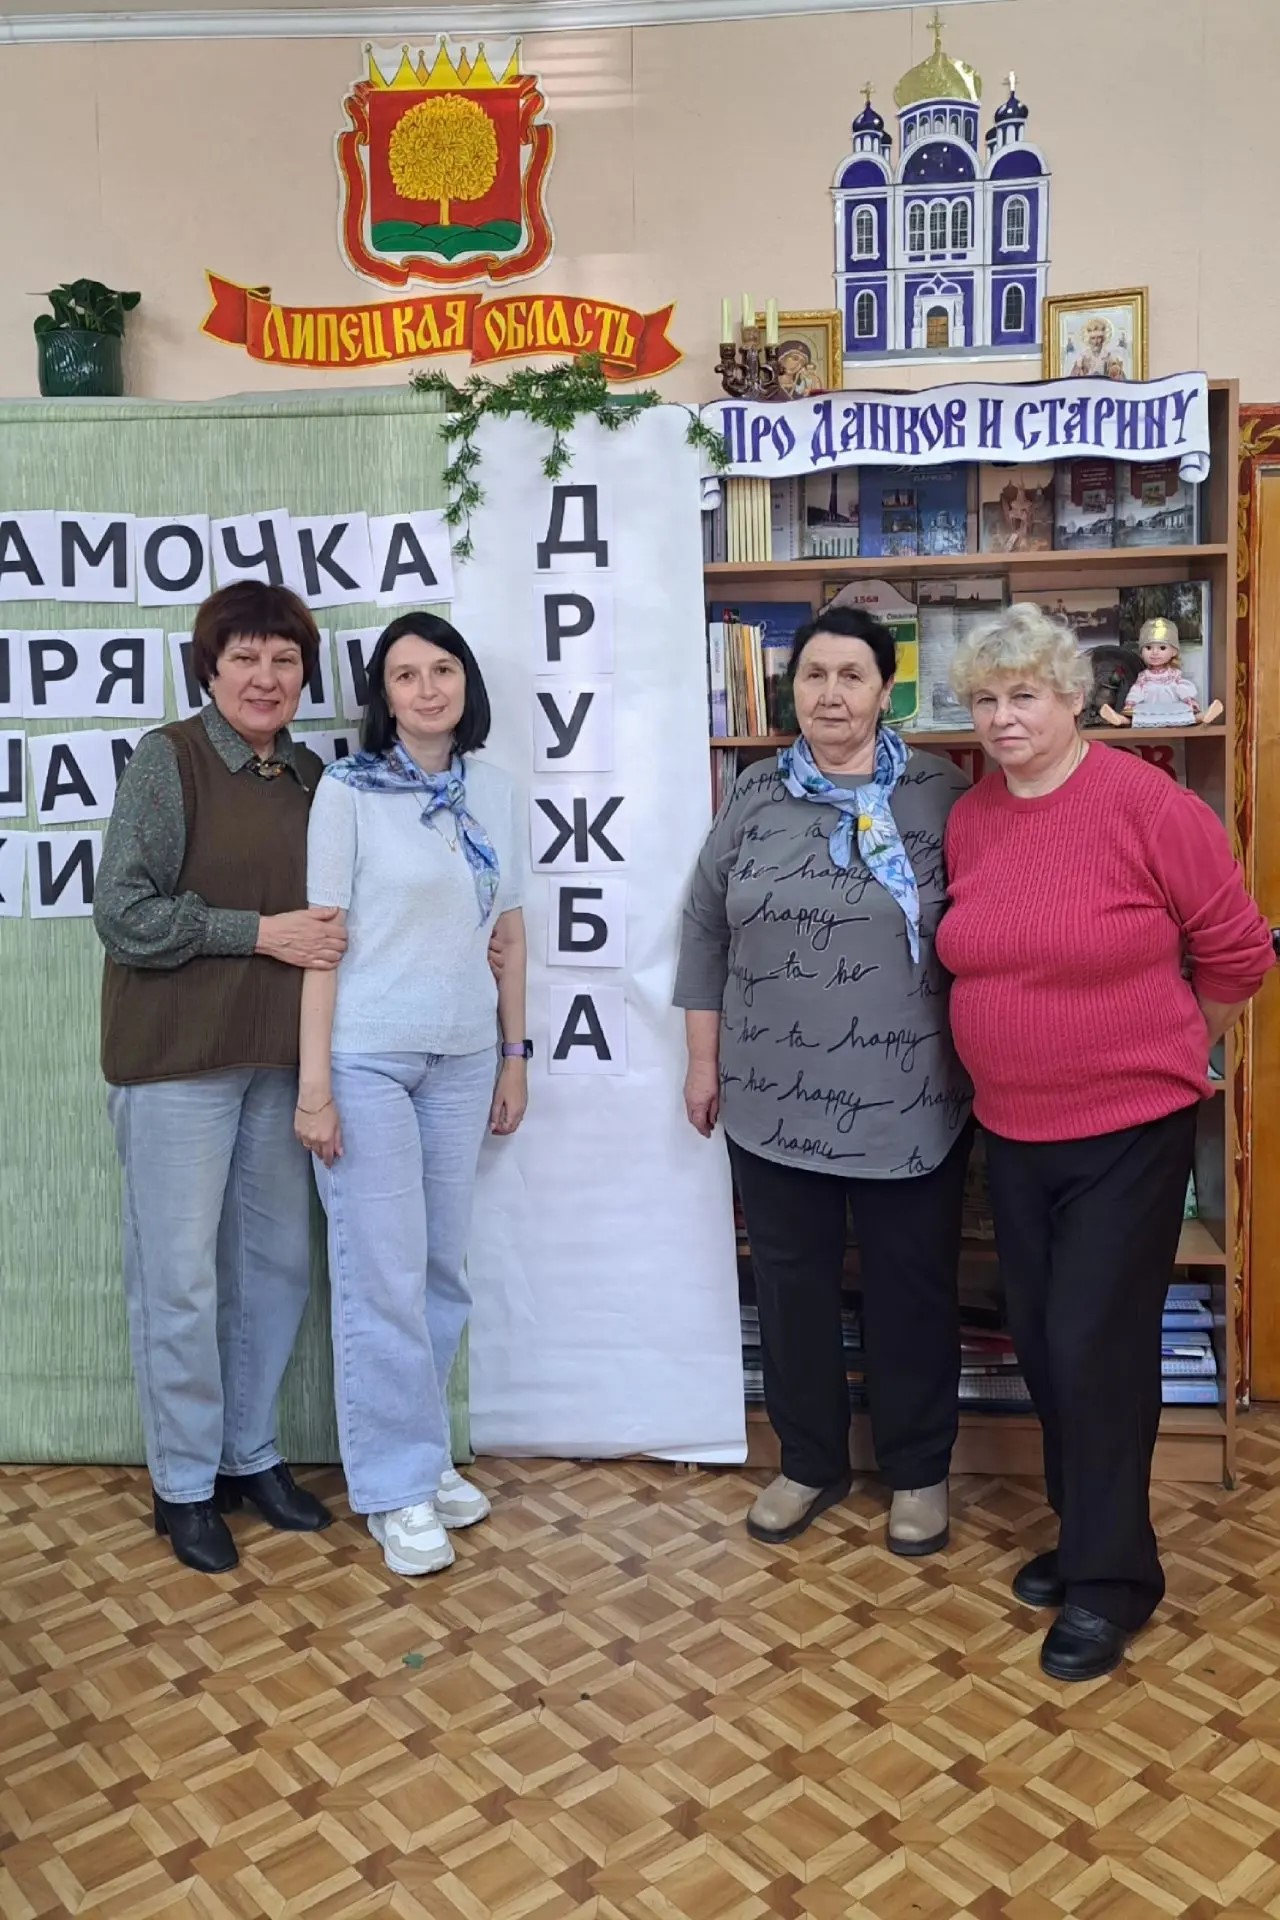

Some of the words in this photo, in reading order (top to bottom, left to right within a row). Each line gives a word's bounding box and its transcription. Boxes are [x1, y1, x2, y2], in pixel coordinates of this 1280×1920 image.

[483, 300, 636, 359] ОБЛАСТЬ
[978, 397, 1003, 452] И
[741, 891, 870, 951] happy
[827, 1016, 941, 1073] happy
[777, 1069, 894, 1134] happy
